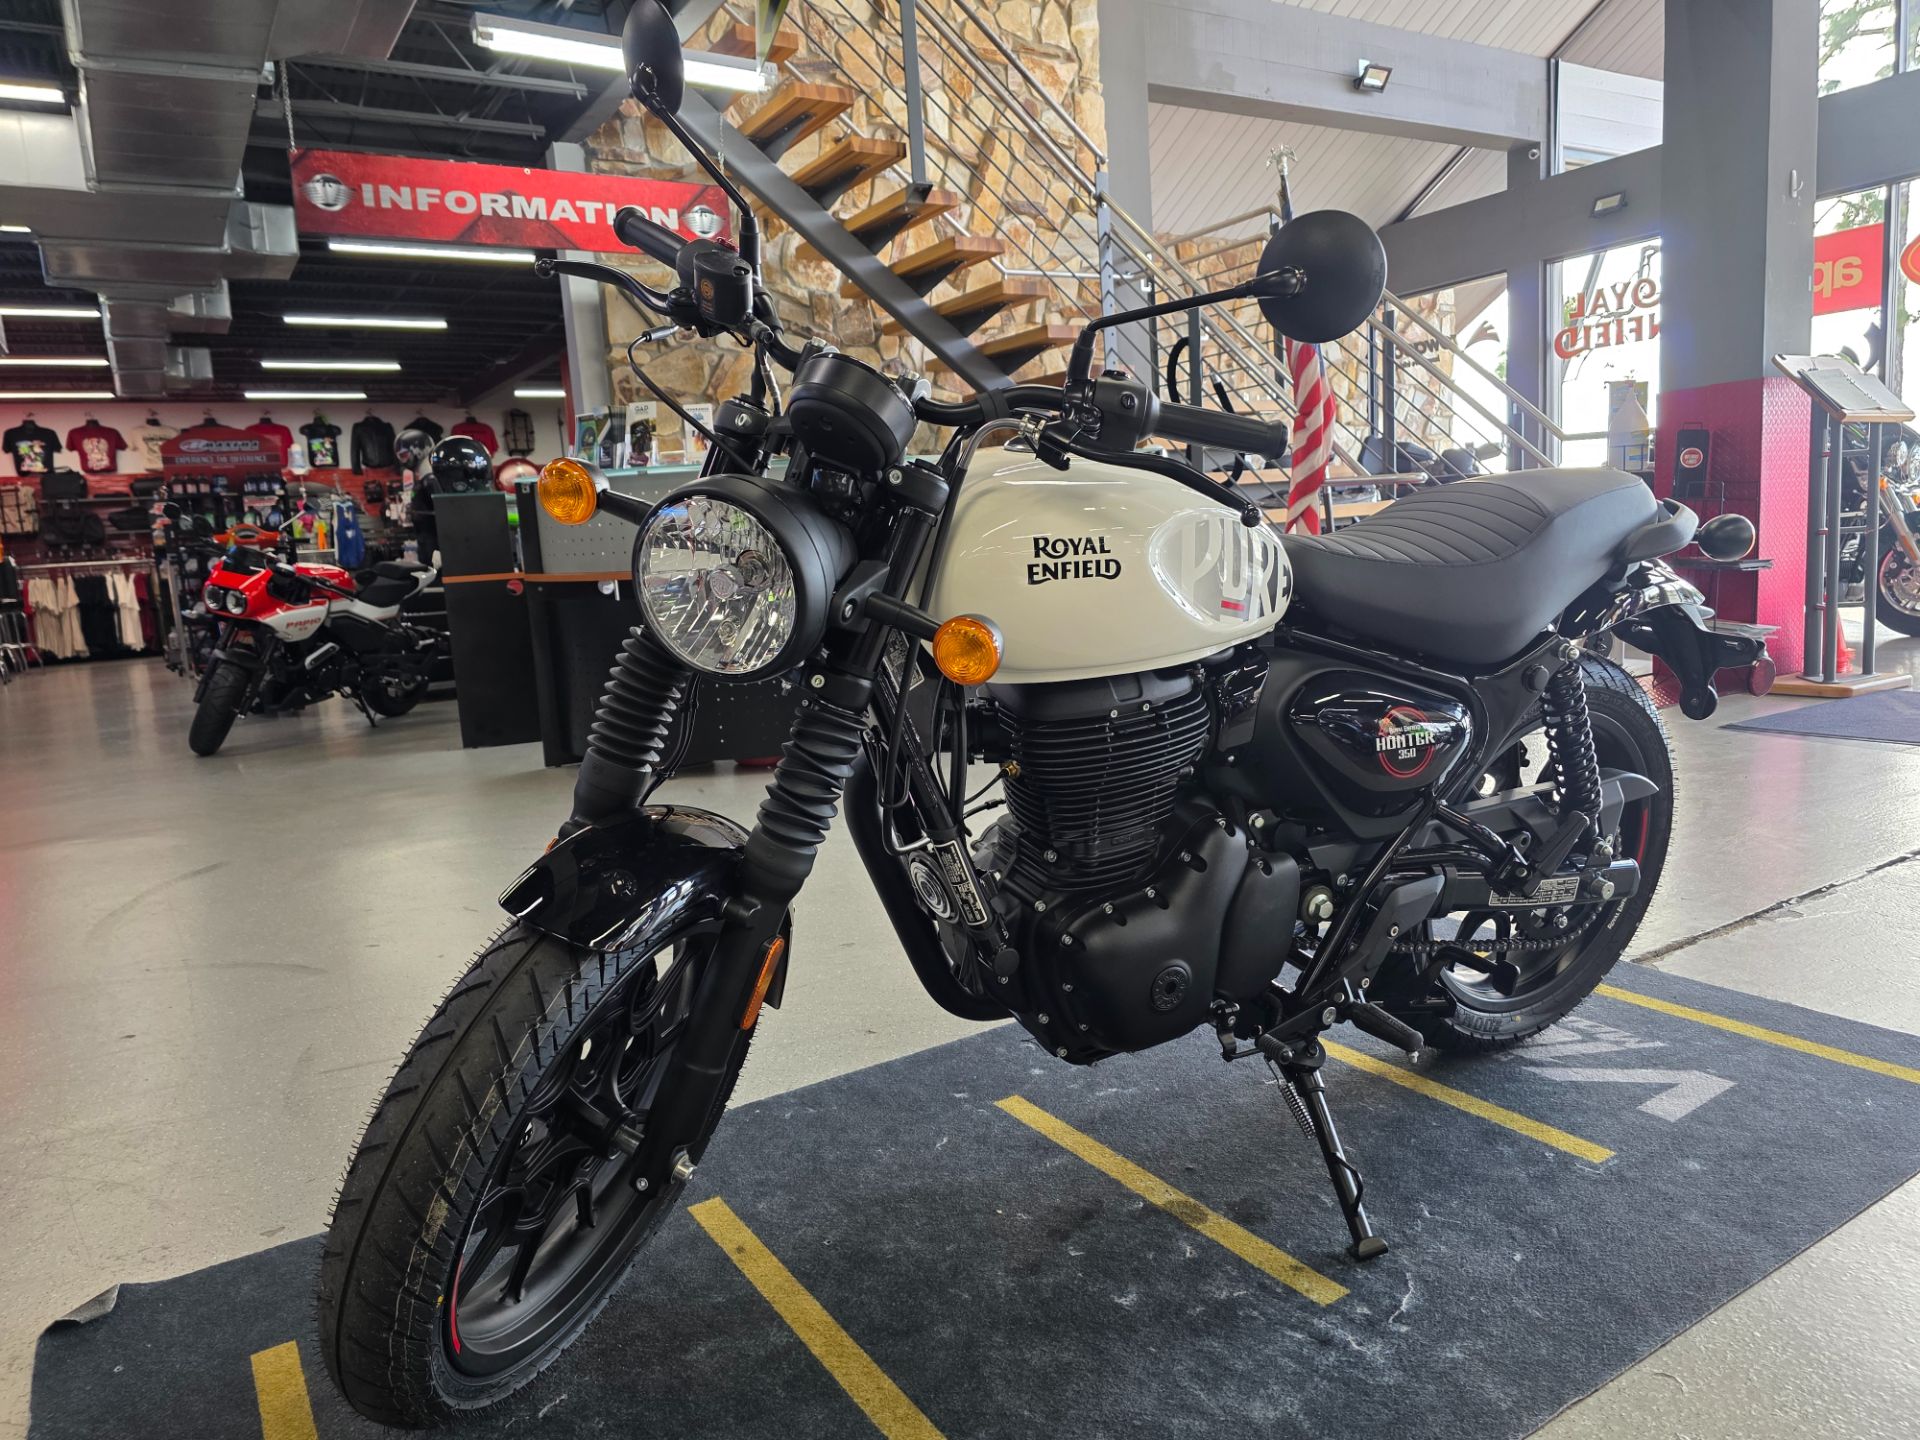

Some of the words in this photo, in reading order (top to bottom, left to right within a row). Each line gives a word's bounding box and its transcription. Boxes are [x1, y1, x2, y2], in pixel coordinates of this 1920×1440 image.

[361, 183, 679, 231] INFORMATIN
[1033, 536, 1111, 560] ROYAL
[1027, 558, 1121, 585] ENFIELD
[1398, 747, 1416, 760] 350
